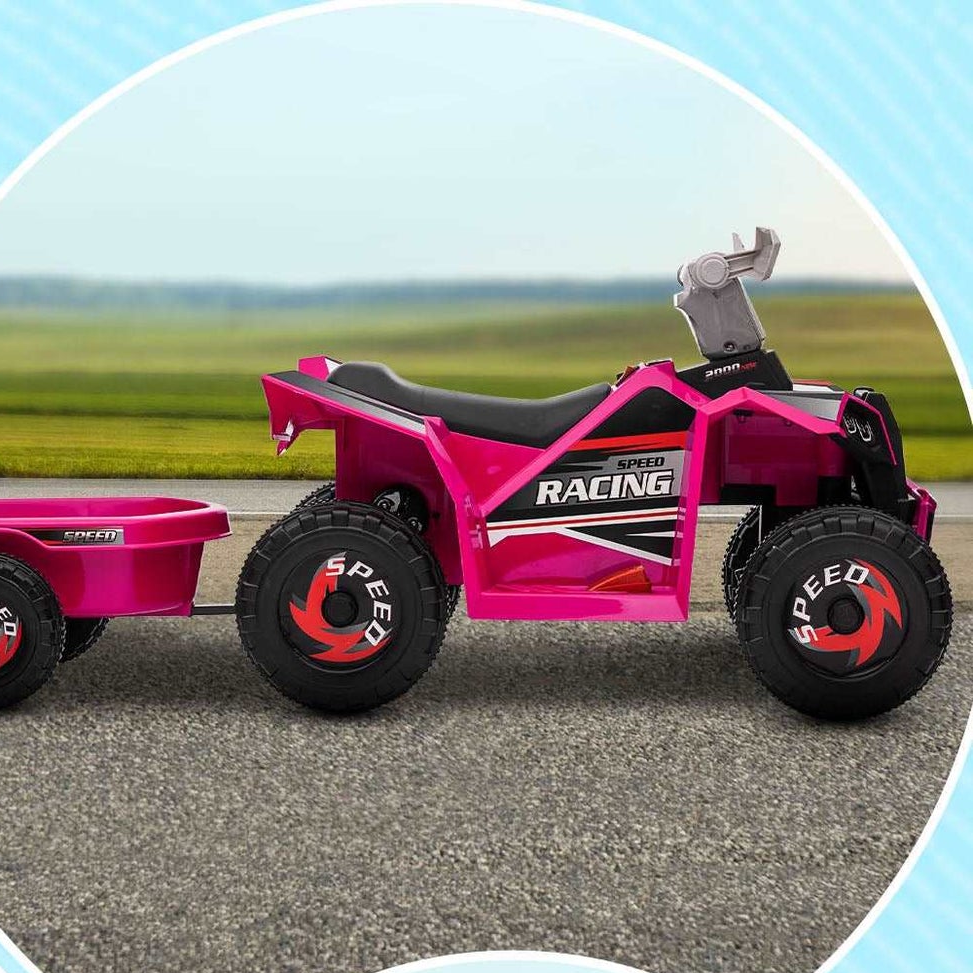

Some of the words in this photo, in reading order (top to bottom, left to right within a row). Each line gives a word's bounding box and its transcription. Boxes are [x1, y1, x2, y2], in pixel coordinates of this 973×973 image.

[617, 457, 665, 469] SPEED
[534, 469, 673, 506] RACING
[62, 530, 117, 543] SPEED
[326, 557, 392, 646] SPEED
[793, 564, 869, 643] SPEED
